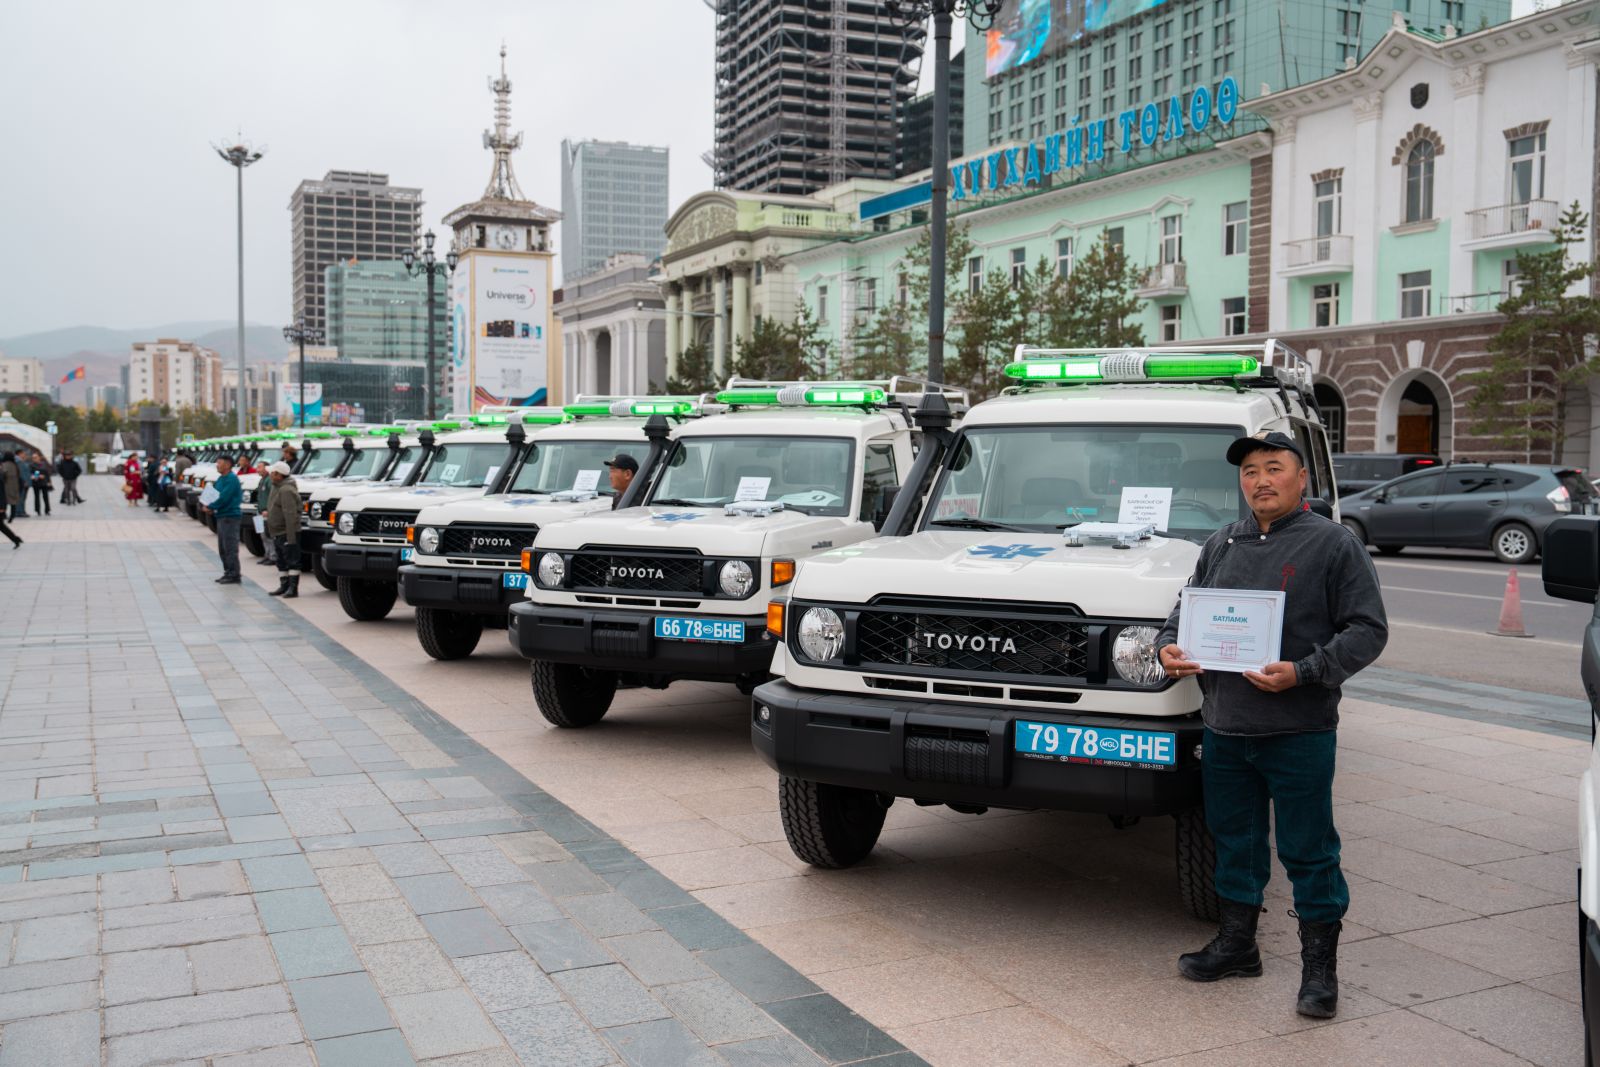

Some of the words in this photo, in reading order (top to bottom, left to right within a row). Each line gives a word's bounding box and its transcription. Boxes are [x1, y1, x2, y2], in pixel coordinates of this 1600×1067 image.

[951, 115, 1105, 201] ХҮҮХДИЙН
[1119, 76, 1239, 153] ТӨЛӨӨ
[486, 289, 526, 301] Universe
[379, 520, 409, 528] TOYOTA
[472, 537, 511, 547] TOYOTA
[610, 566, 664, 579] TOYOTA
[508, 574, 522, 587] 37
[1213, 615, 1248, 623] БАТЛАМЖ
[662, 619, 680, 636] 66
[684, 620, 703, 638] 78
[713, 622, 741, 639] БНЕ
[923, 632, 1017, 653] TOYOTA
[1028, 724, 1059, 752] 79
[1066, 727, 1099, 756] 78
[1120, 733, 1171, 762] БНЕ
